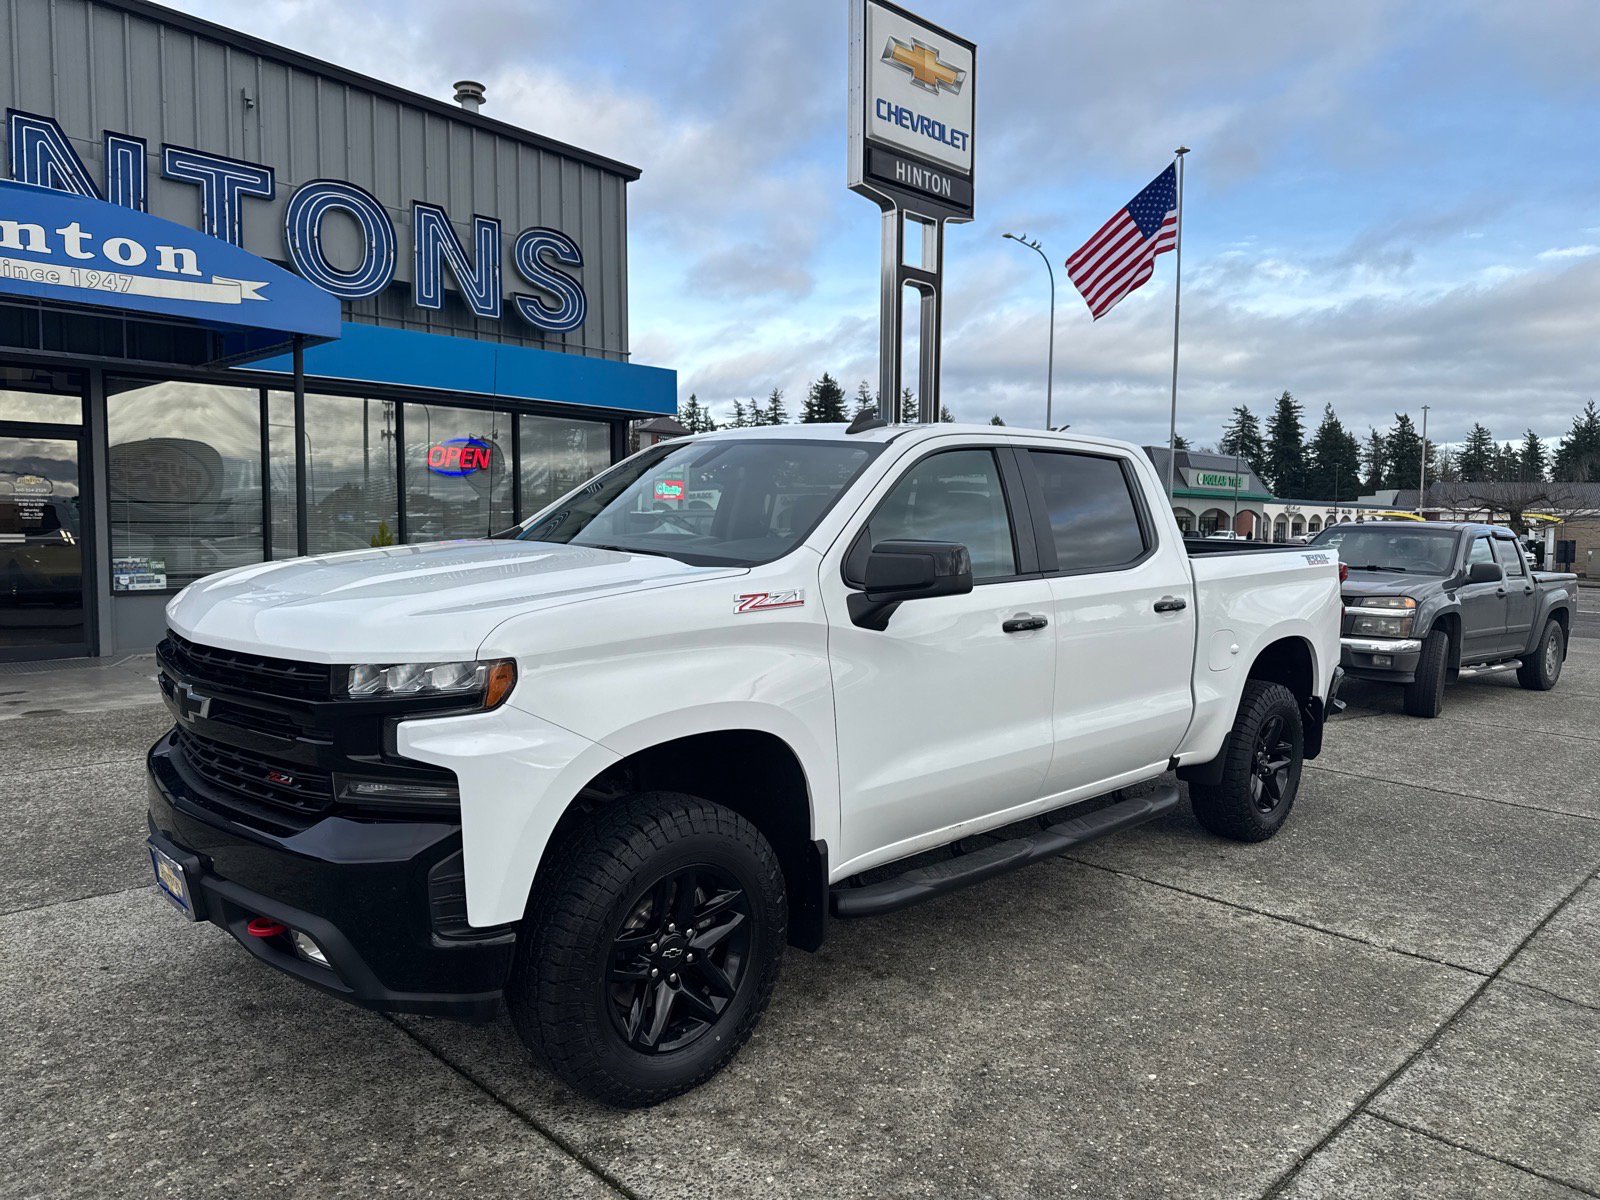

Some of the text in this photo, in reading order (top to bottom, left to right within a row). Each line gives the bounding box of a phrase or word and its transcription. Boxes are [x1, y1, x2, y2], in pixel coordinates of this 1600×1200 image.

[876, 98, 969, 152] CHEVROLET
[895, 160, 951, 197] HINTON
[0, 219, 203, 277] nton
[2, 259, 134, 293] ince 1947
[427, 445, 491, 470] OPEN
[1228, 475, 1243, 488] TRE
[733, 589, 805, 614] Z71
